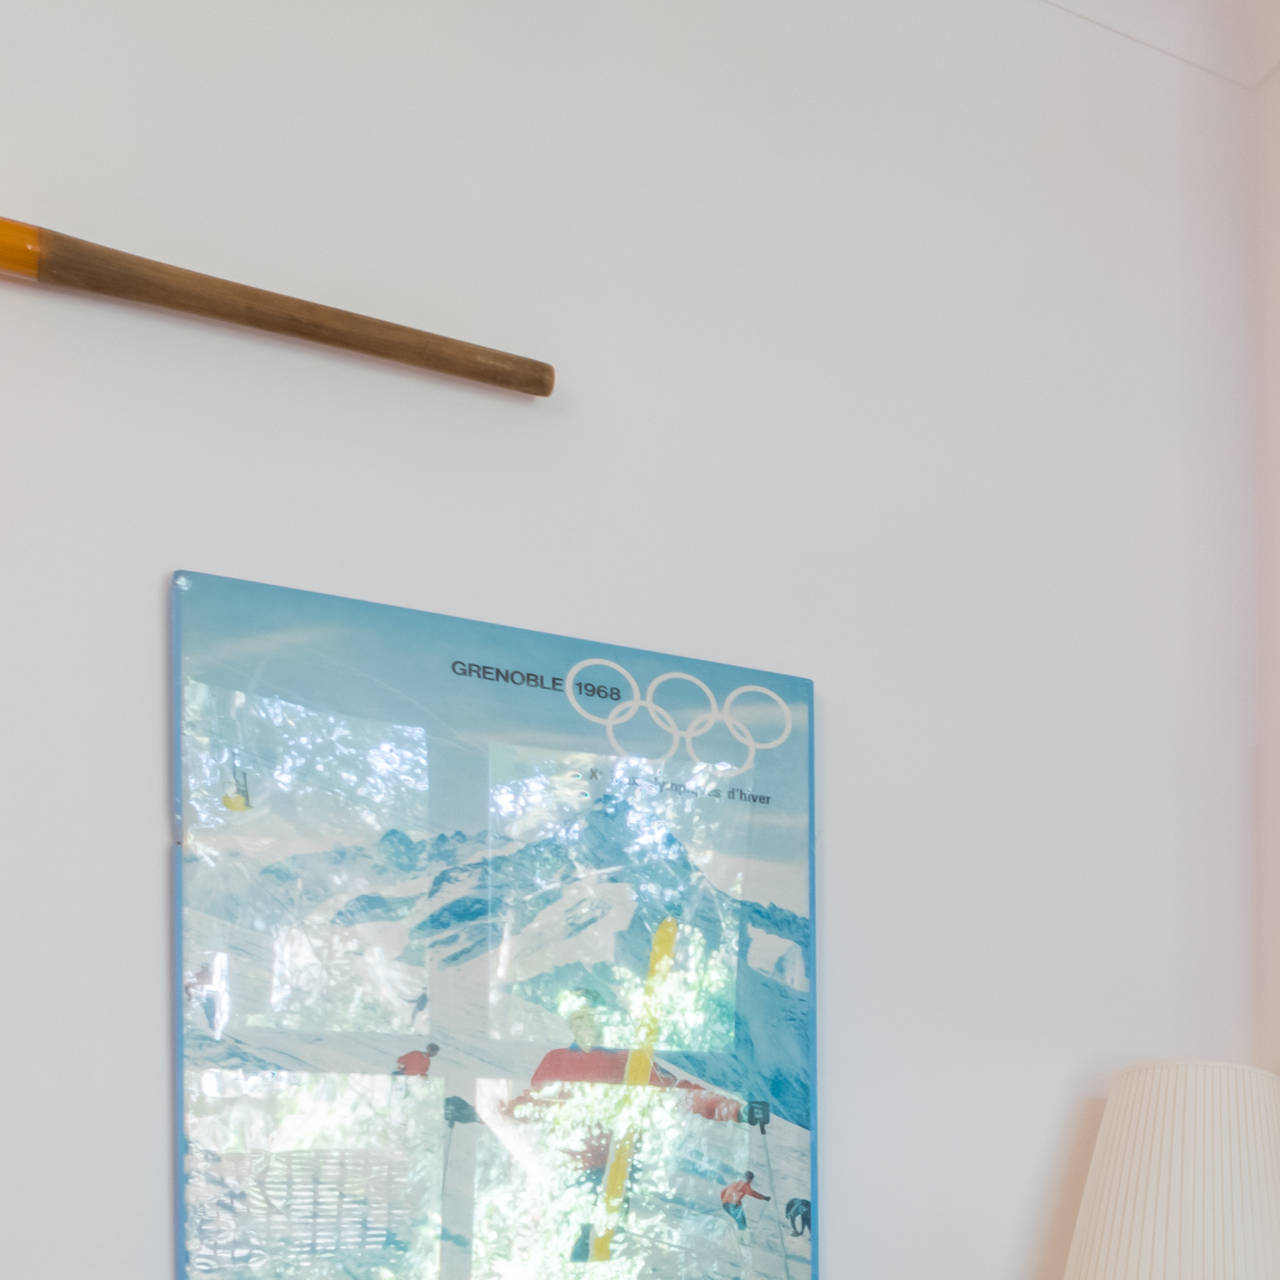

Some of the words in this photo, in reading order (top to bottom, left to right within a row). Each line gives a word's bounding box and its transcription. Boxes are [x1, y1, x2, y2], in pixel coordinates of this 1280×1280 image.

[451, 659, 564, 692] GRENOBLE
[575, 681, 622, 701] 1968
[728, 787, 771, 805] d'hiver
